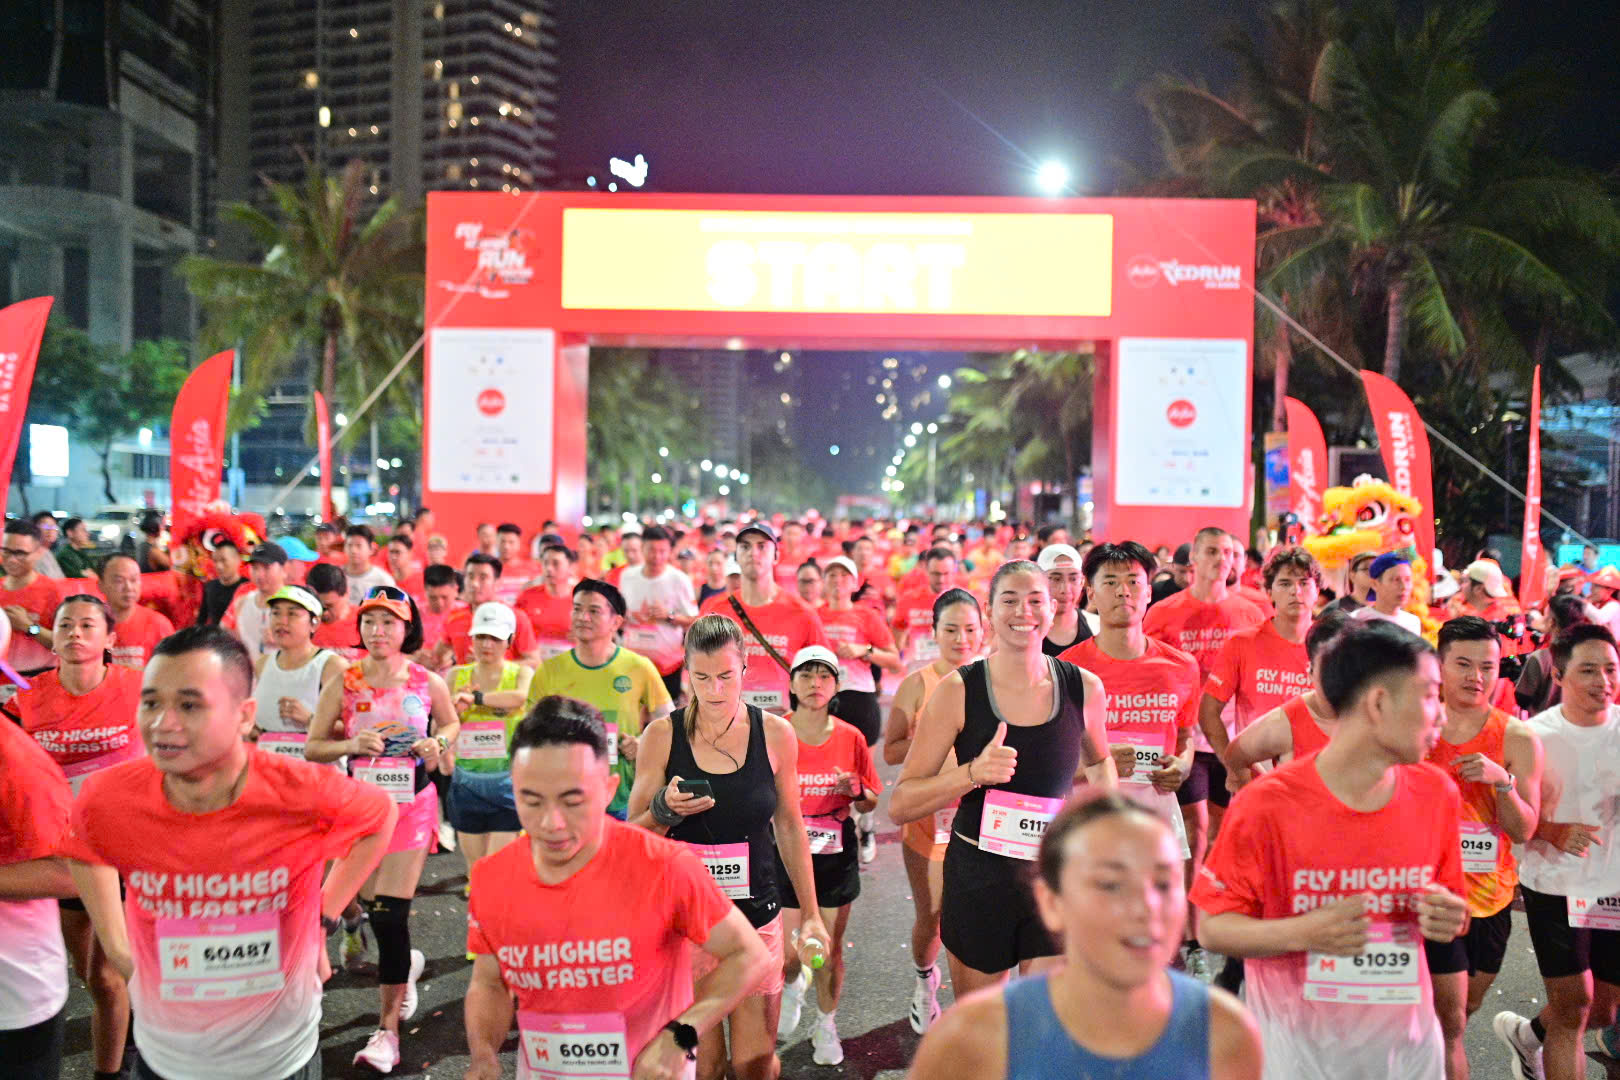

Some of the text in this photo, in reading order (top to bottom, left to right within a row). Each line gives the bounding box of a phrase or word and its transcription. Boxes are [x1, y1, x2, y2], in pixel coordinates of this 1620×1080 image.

[706, 240, 967, 308] START
[1256, 669, 1279, 681] FLY
[1256, 683, 1283, 694] RUN
[1114, 693, 1178, 708] HIGHER
[1122, 710, 1177, 723] FASTER
[70, 733, 128, 753] FASTER
[376, 773, 410, 783] 60855
[993, 820, 1002, 830] F
[1461, 840, 1492, 850] 0149
[173, 866, 289, 898] HIGHER
[1294, 870, 1335, 890] FLY
[1576, 898, 1587, 909] M
[204, 941, 272, 961] 60487
[498, 938, 632, 968] FLY HIGHER
[173, 956, 188, 969] M
[1320, 959, 1335, 972] M
[1354, 953, 1410, 967] 61039
[546, 964, 634, 990] FASTER
[536, 1048, 549, 1062] M
[560, 1043, 620, 1057] 60607
